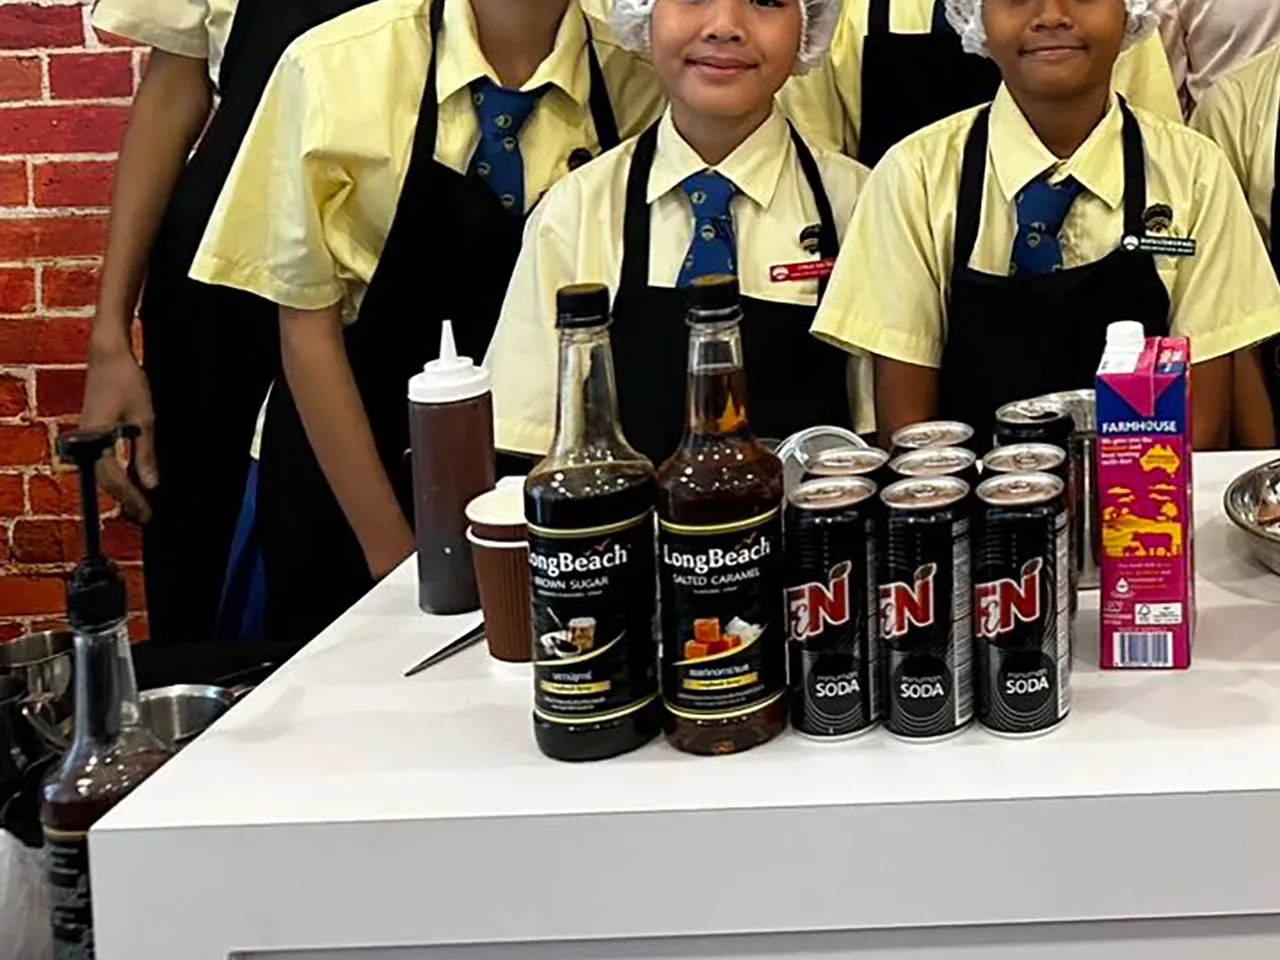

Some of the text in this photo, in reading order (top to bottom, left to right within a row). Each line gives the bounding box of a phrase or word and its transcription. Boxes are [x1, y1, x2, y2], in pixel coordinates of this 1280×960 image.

[1102, 420, 1177, 434] FARMHOUSE
[528, 544, 628, 577] ongBeach
[663, 536, 771, 574] LongBeach
[569, 576, 609, 589] SUGAR
[672, 567, 760, 586] SALTED CARAMEL
[816, 679, 861, 697] SODA
[900, 683, 944, 698] SODA
[1006, 676, 1049, 694] SODA
